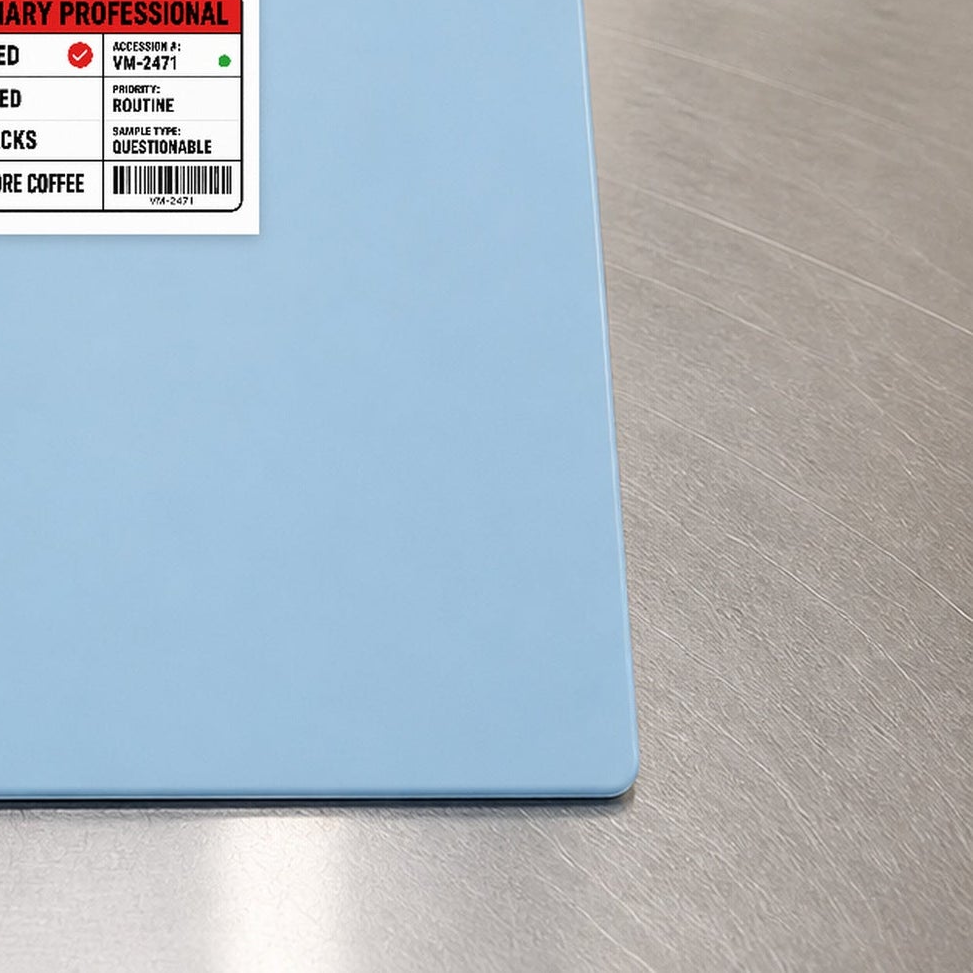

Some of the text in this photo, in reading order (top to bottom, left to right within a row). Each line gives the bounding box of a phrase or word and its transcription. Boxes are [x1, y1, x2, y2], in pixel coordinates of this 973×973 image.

[59, 0, 229, 26] PROFESSIONAL
[112, 41, 168, 52] ACCESSION
[112, 55, 177, 71] VM-2471
[112, 84, 161, 94] PRIORITY:
[112, 97, 175, 113] ROUTINE
[112, 126, 181, 136] SAMPLE TYPE:
[112, 138, 212, 155] QUESTIONABLE
[27, 173, 85, 194] COFFEE
[149, 196, 194, 206] VM-2471
